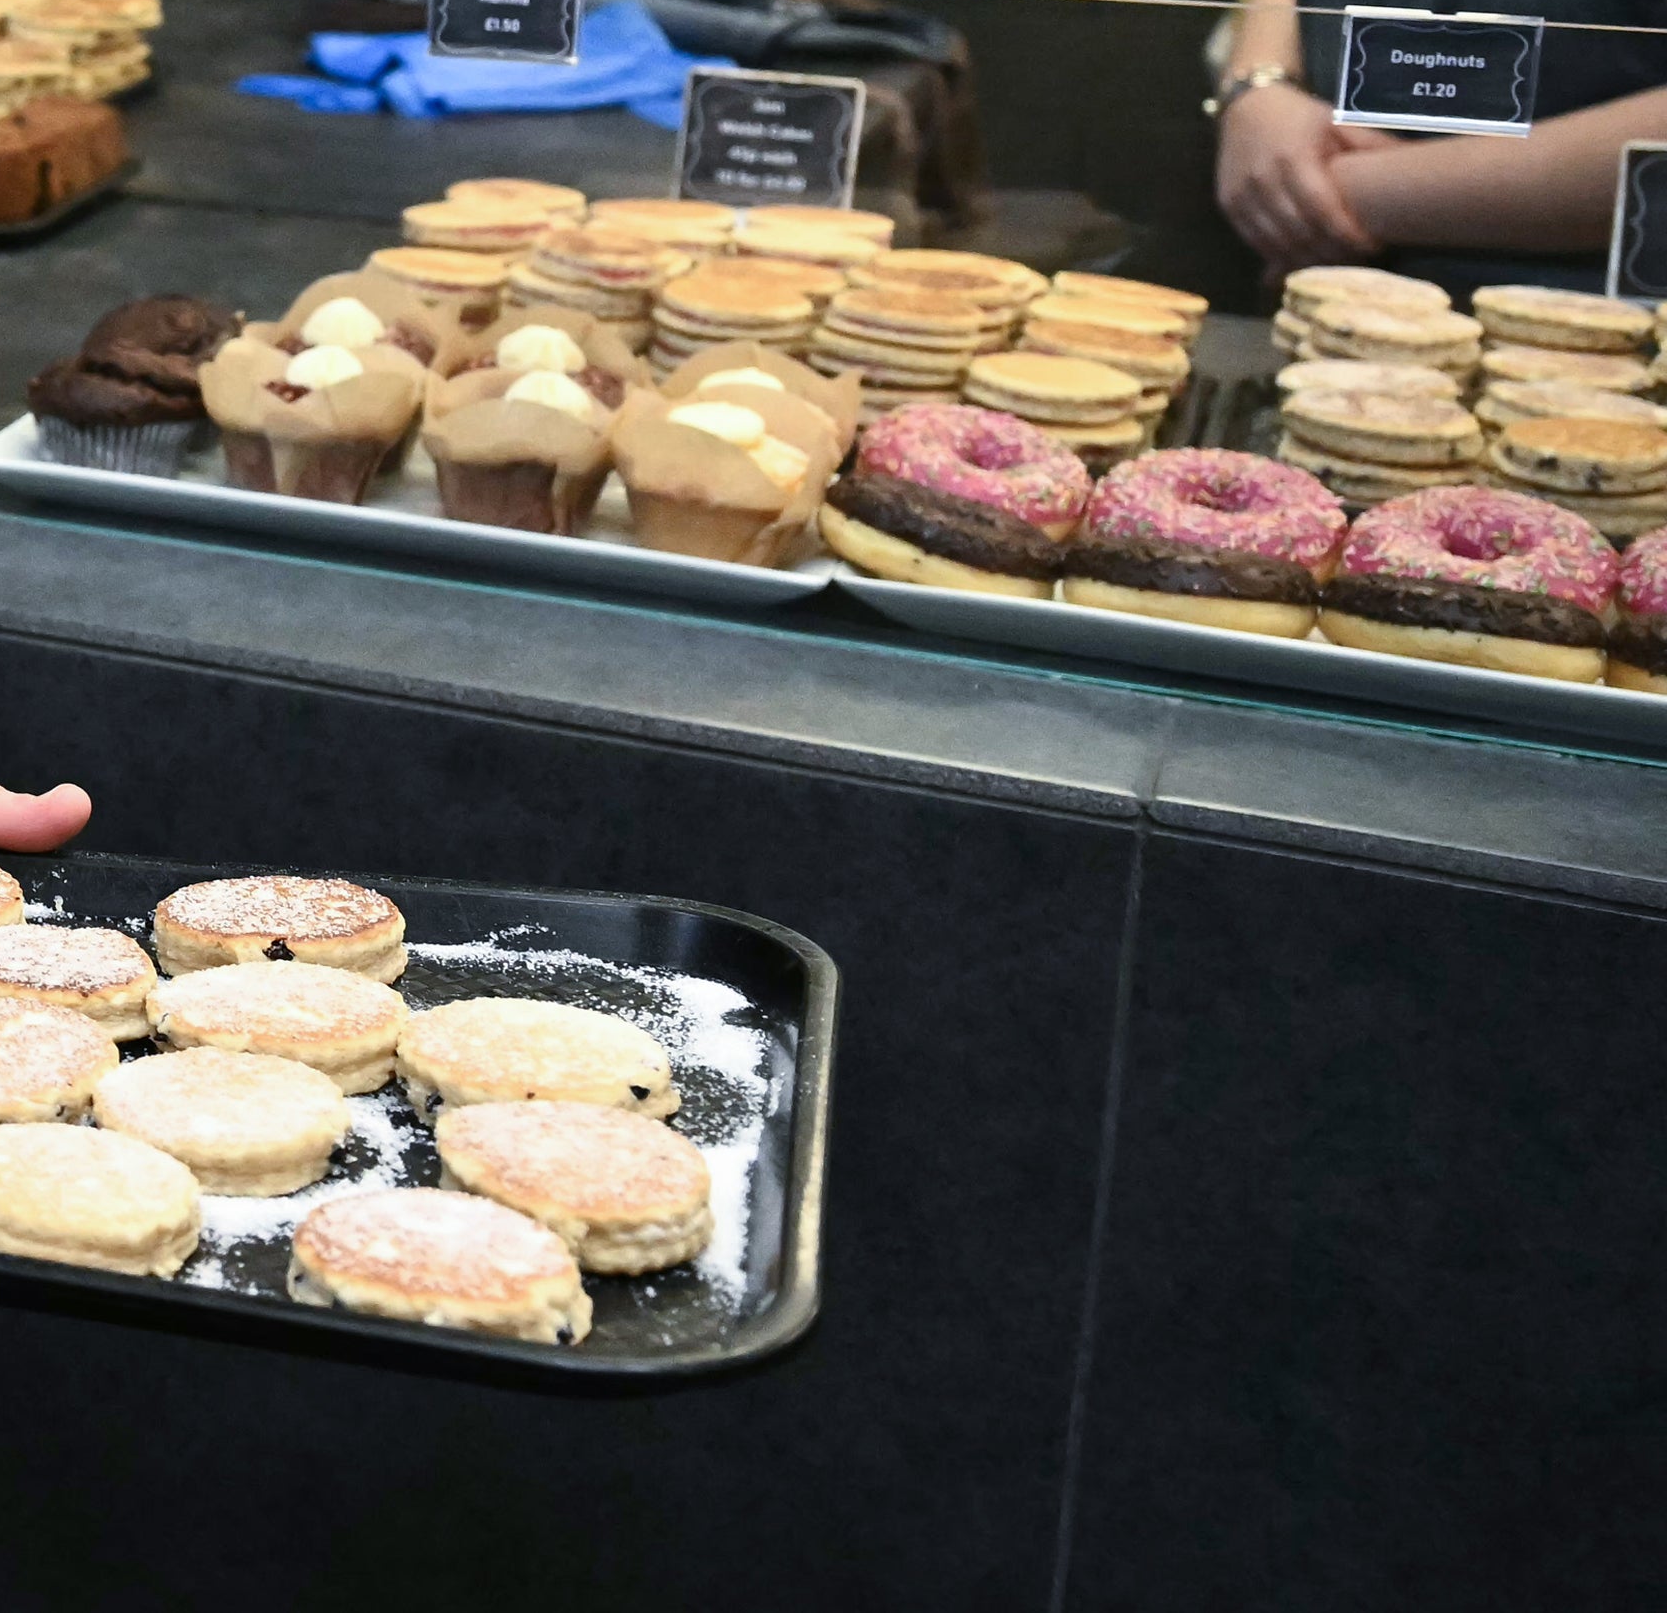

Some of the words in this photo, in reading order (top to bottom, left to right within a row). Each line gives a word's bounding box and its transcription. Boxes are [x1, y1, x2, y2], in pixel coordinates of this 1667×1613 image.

[483, 16, 521, 33] £1.50
[1390, 48, 1487, 70] Doughnuts
[1412, 81, 1457, 99] £1.20
